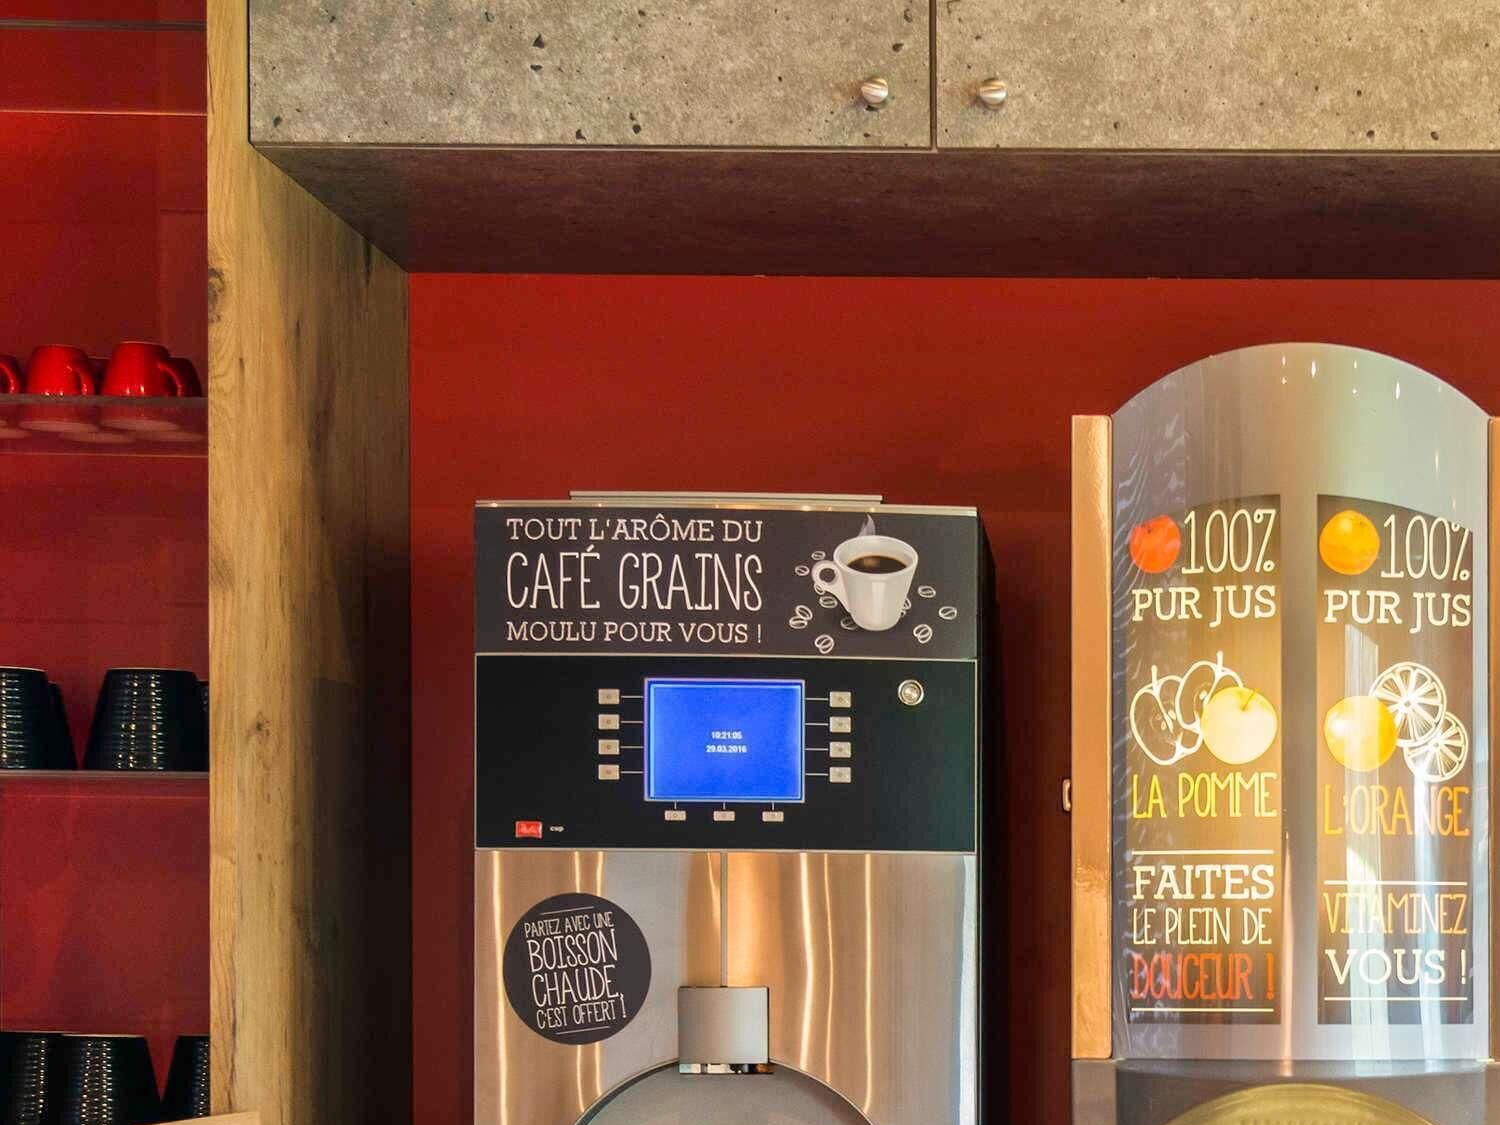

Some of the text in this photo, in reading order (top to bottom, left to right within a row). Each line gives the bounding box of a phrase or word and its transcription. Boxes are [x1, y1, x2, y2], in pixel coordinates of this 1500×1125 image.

[506, 514, 763, 543] TOUT L'ARÔME DU
[1181, 509, 1276, 575] 100%
[1381, 514, 1473, 580] 100%
[506, 544, 763, 612] CAFÉ GRAINS
[1131, 585, 1276, 628] PUR JUS
[1324, 589, 1471, 634] PUR JUS
[506, 621, 597, 642] MOULU
[604, 622, 672, 643] POUR
[678, 622, 749, 644] VOUS
[1132, 772, 1278, 818] LA POMME
[1323, 786, 1470, 837] L'ORANGE
[1132, 864, 1275, 901] FAITES
[524, 912, 614, 938] PARTEZ AVEC UNE
[1132, 908, 1272, 945] LE PLEIN DE
[1323, 893, 1468, 936] VITAMINEZ
[526, 929, 618, 972] BOISSON
[1325, 949, 1445, 986] VOUS
[1131, 952, 1253, 1000] DOUCEUR
[536, 1005, 568, 1029] C'EST
[572, 999, 617, 1024] OFFERT
